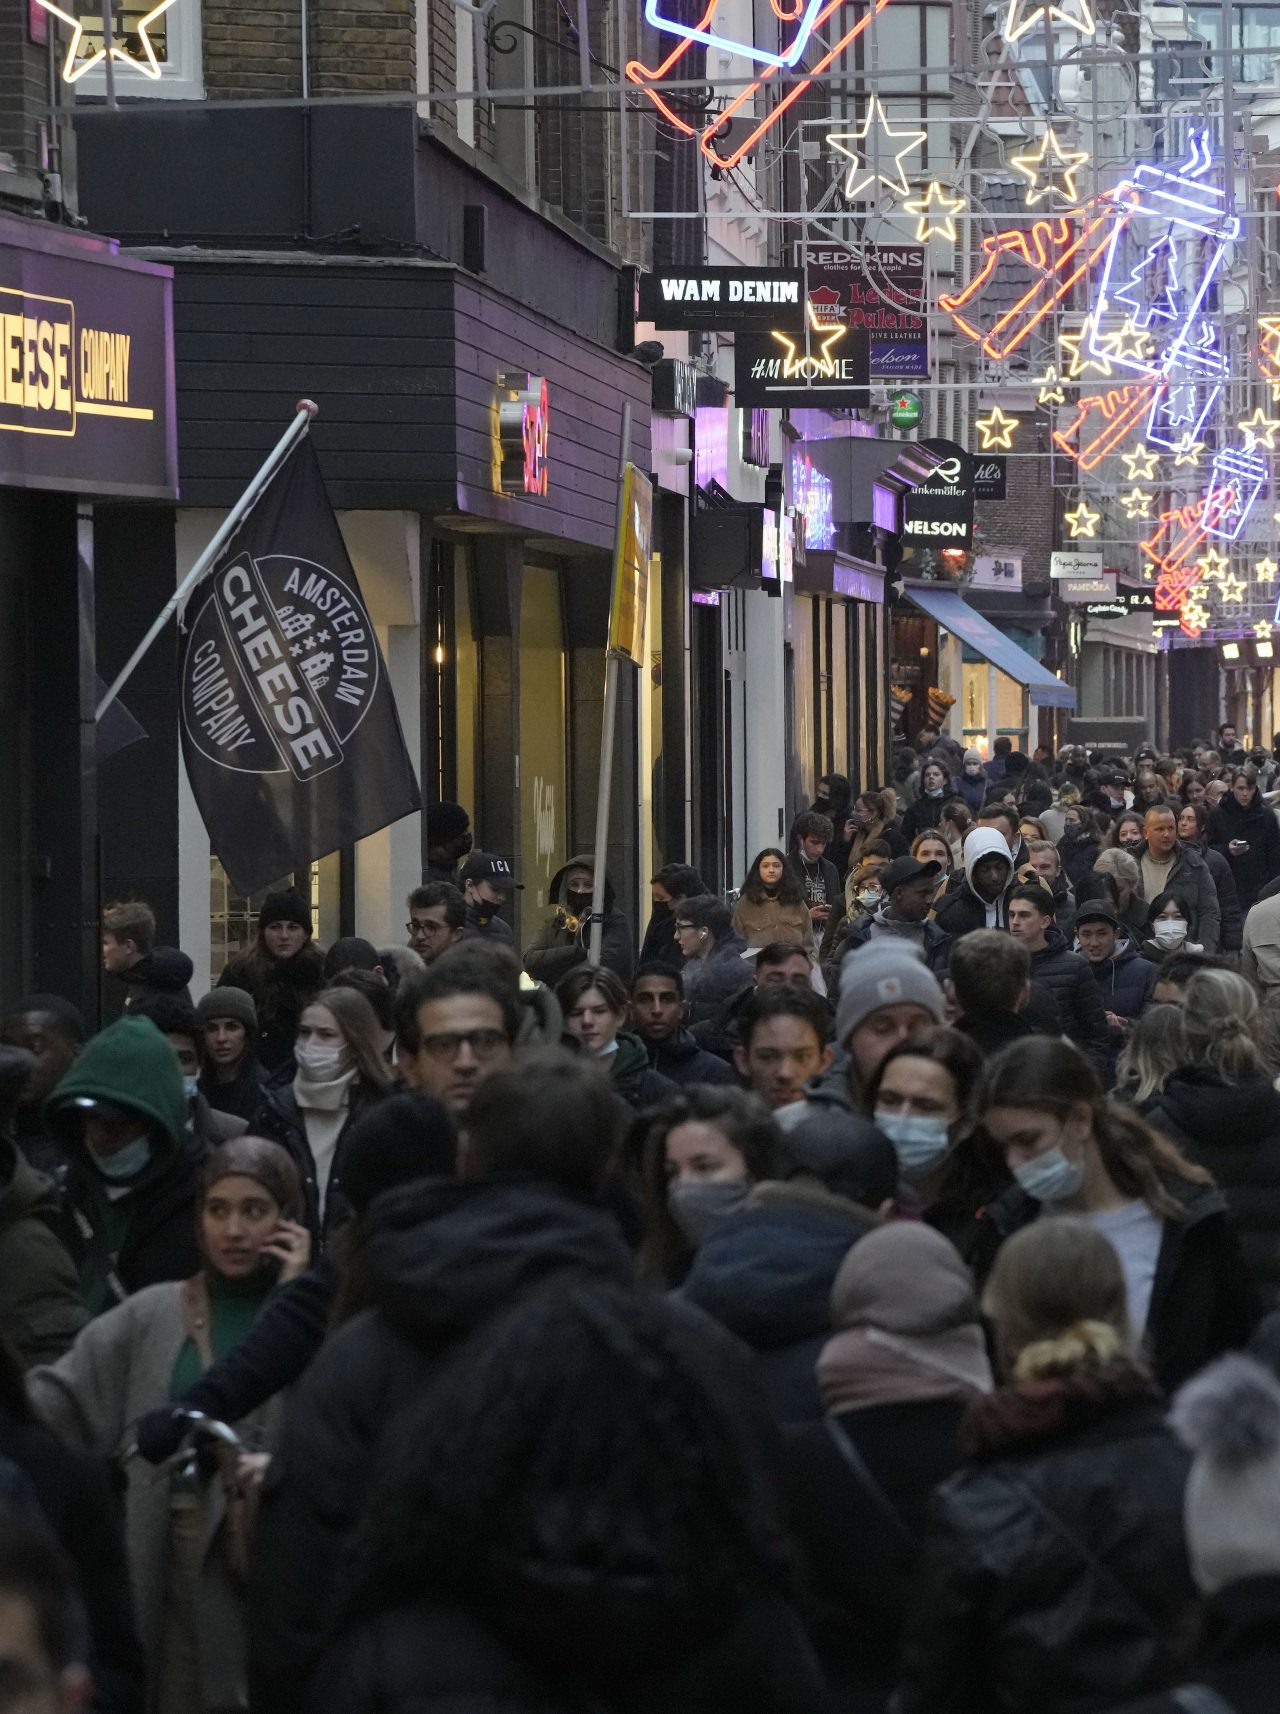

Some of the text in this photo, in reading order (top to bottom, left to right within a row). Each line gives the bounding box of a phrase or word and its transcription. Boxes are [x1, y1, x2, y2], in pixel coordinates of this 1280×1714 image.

[661, 279, 799, 303] WAM DENIM
[0, 311, 131, 415] EESE COMPANY
[870, 348, 921, 365] elson
[911, 484, 967, 496] unkemöller
[904, 520, 967, 537] NELSON
[223, 566, 334, 771] CHEESE
[283, 567, 369, 706] AMSTERDAM
[192, 639, 256, 751] COMPANY
